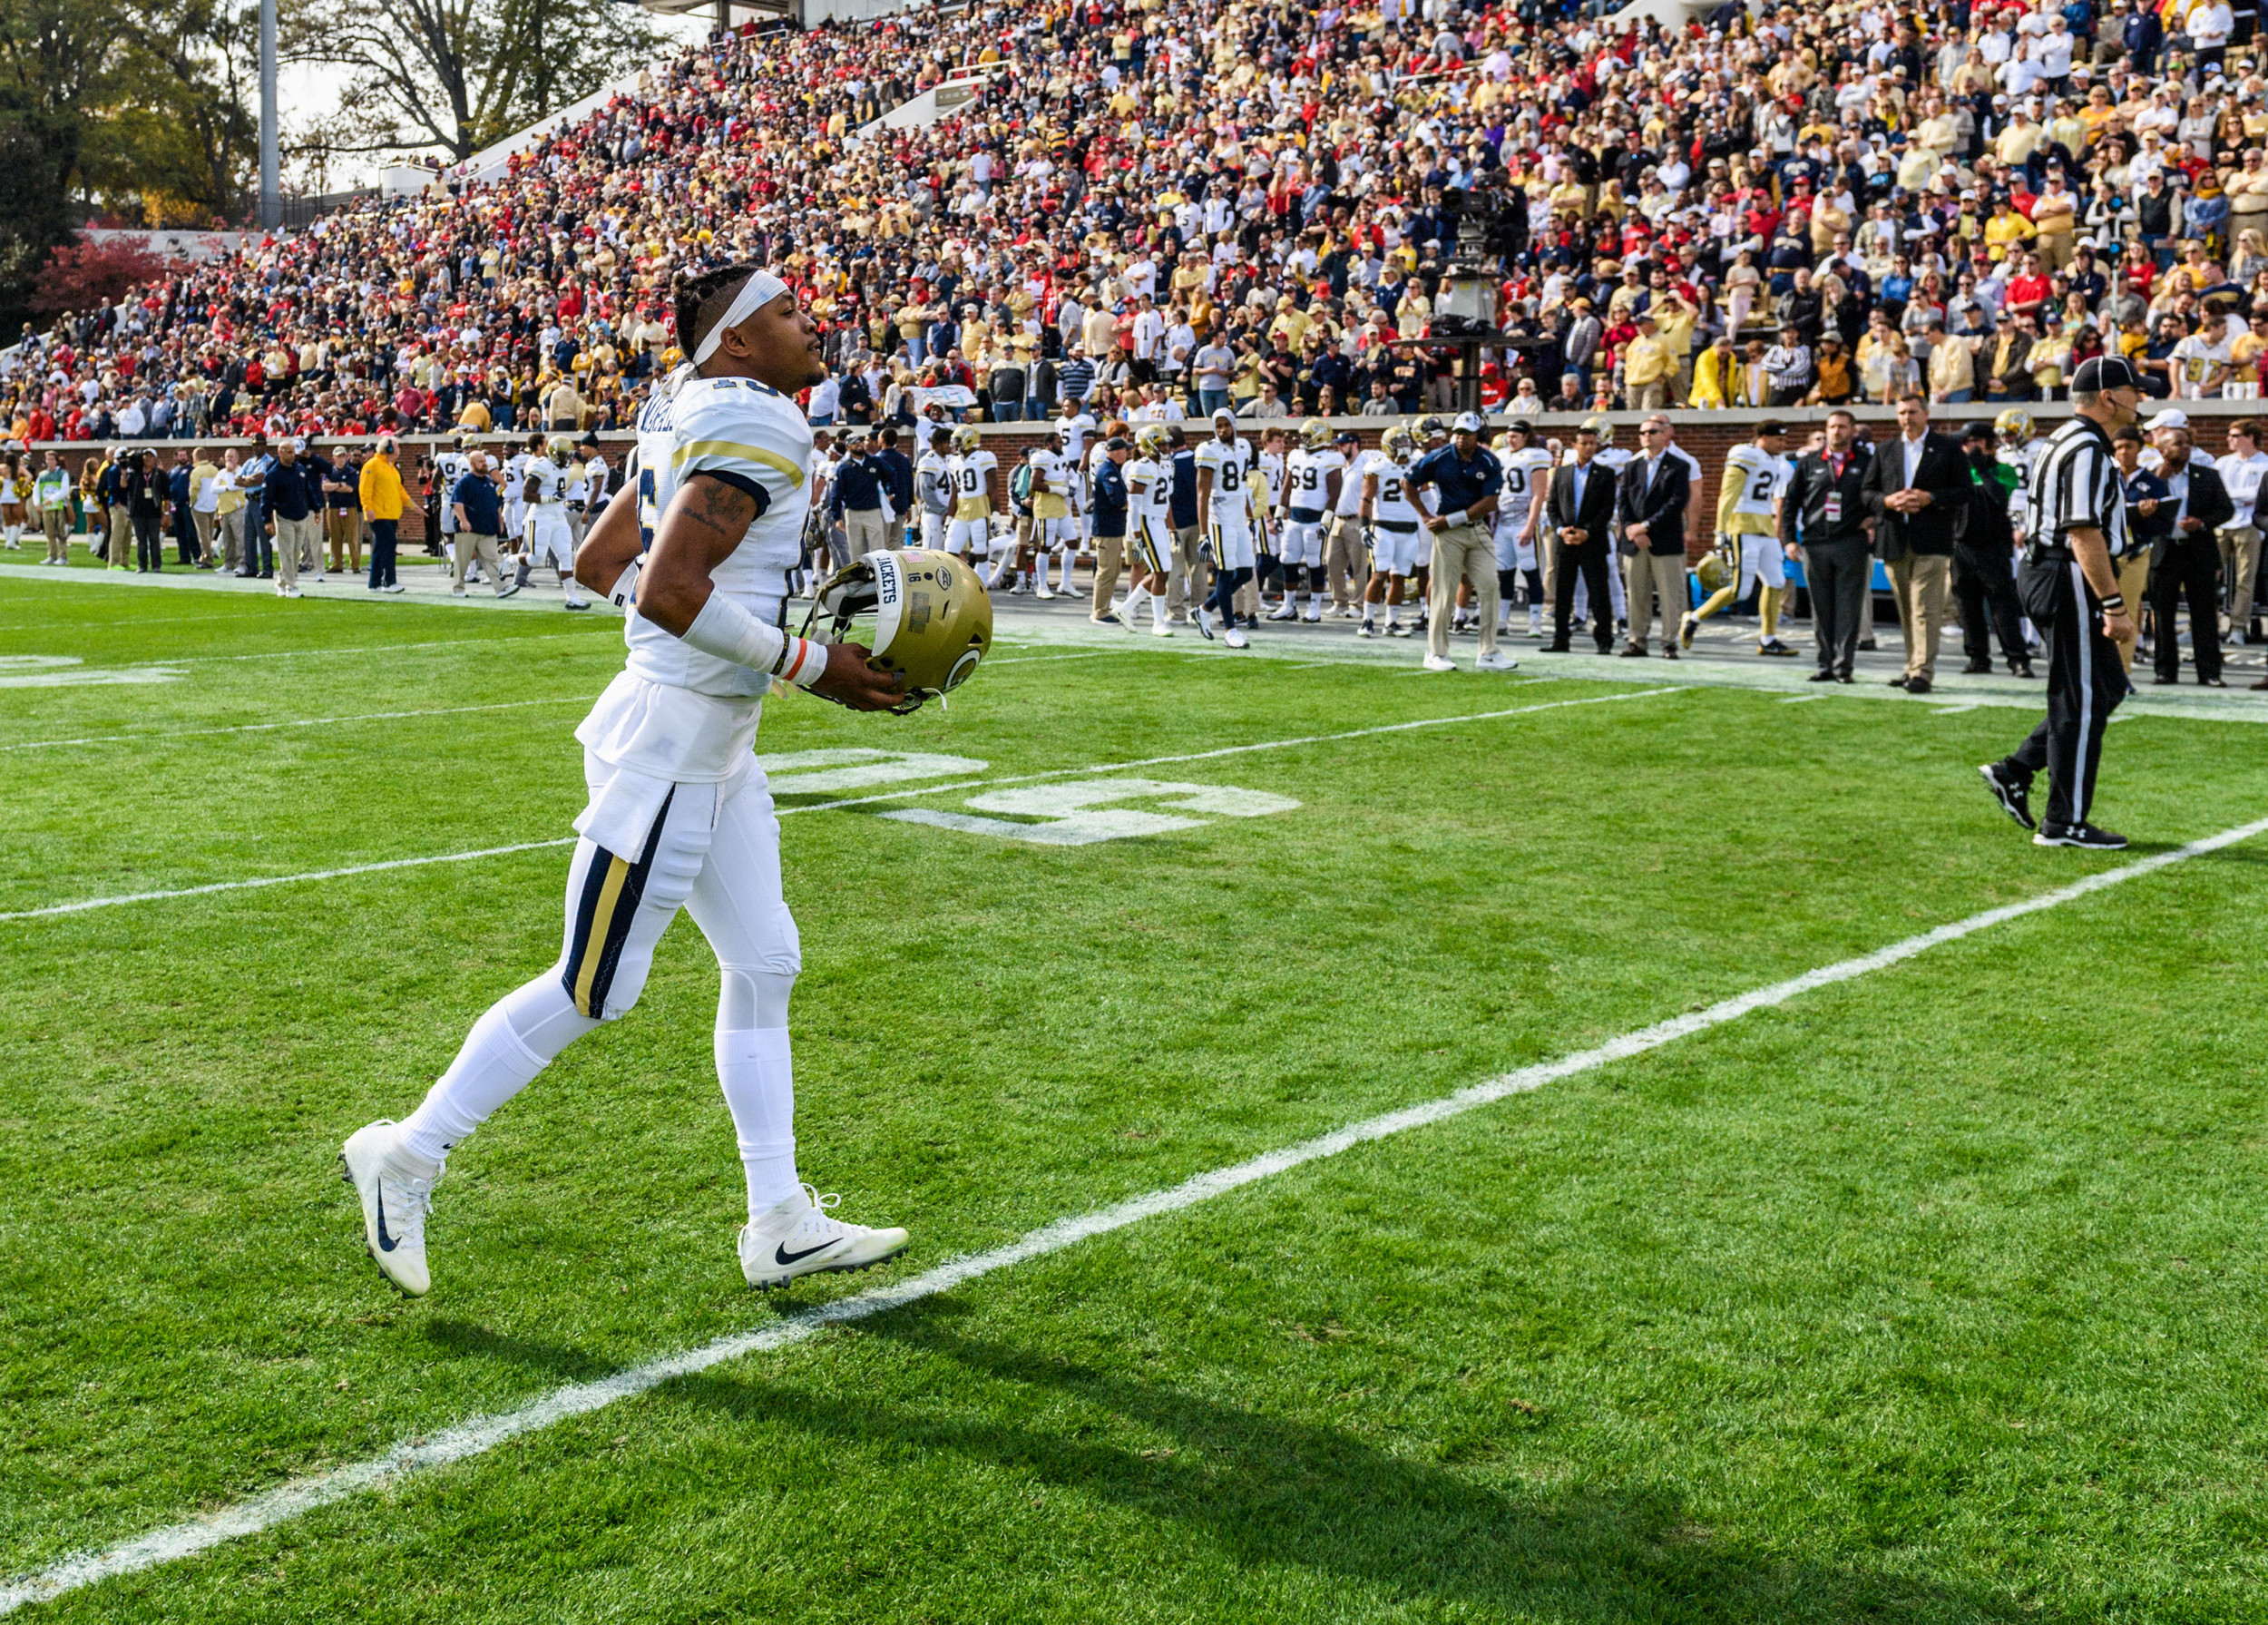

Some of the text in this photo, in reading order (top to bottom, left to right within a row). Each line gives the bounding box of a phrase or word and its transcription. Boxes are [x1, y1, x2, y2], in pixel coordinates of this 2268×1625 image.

[2186, 357, 2221, 385] 97
[1061, 427, 1070, 445] 5
[1291, 465, 1317, 491] 69
[876, 556, 897, 604] JACKETS
[908, 572, 922, 583] 16
